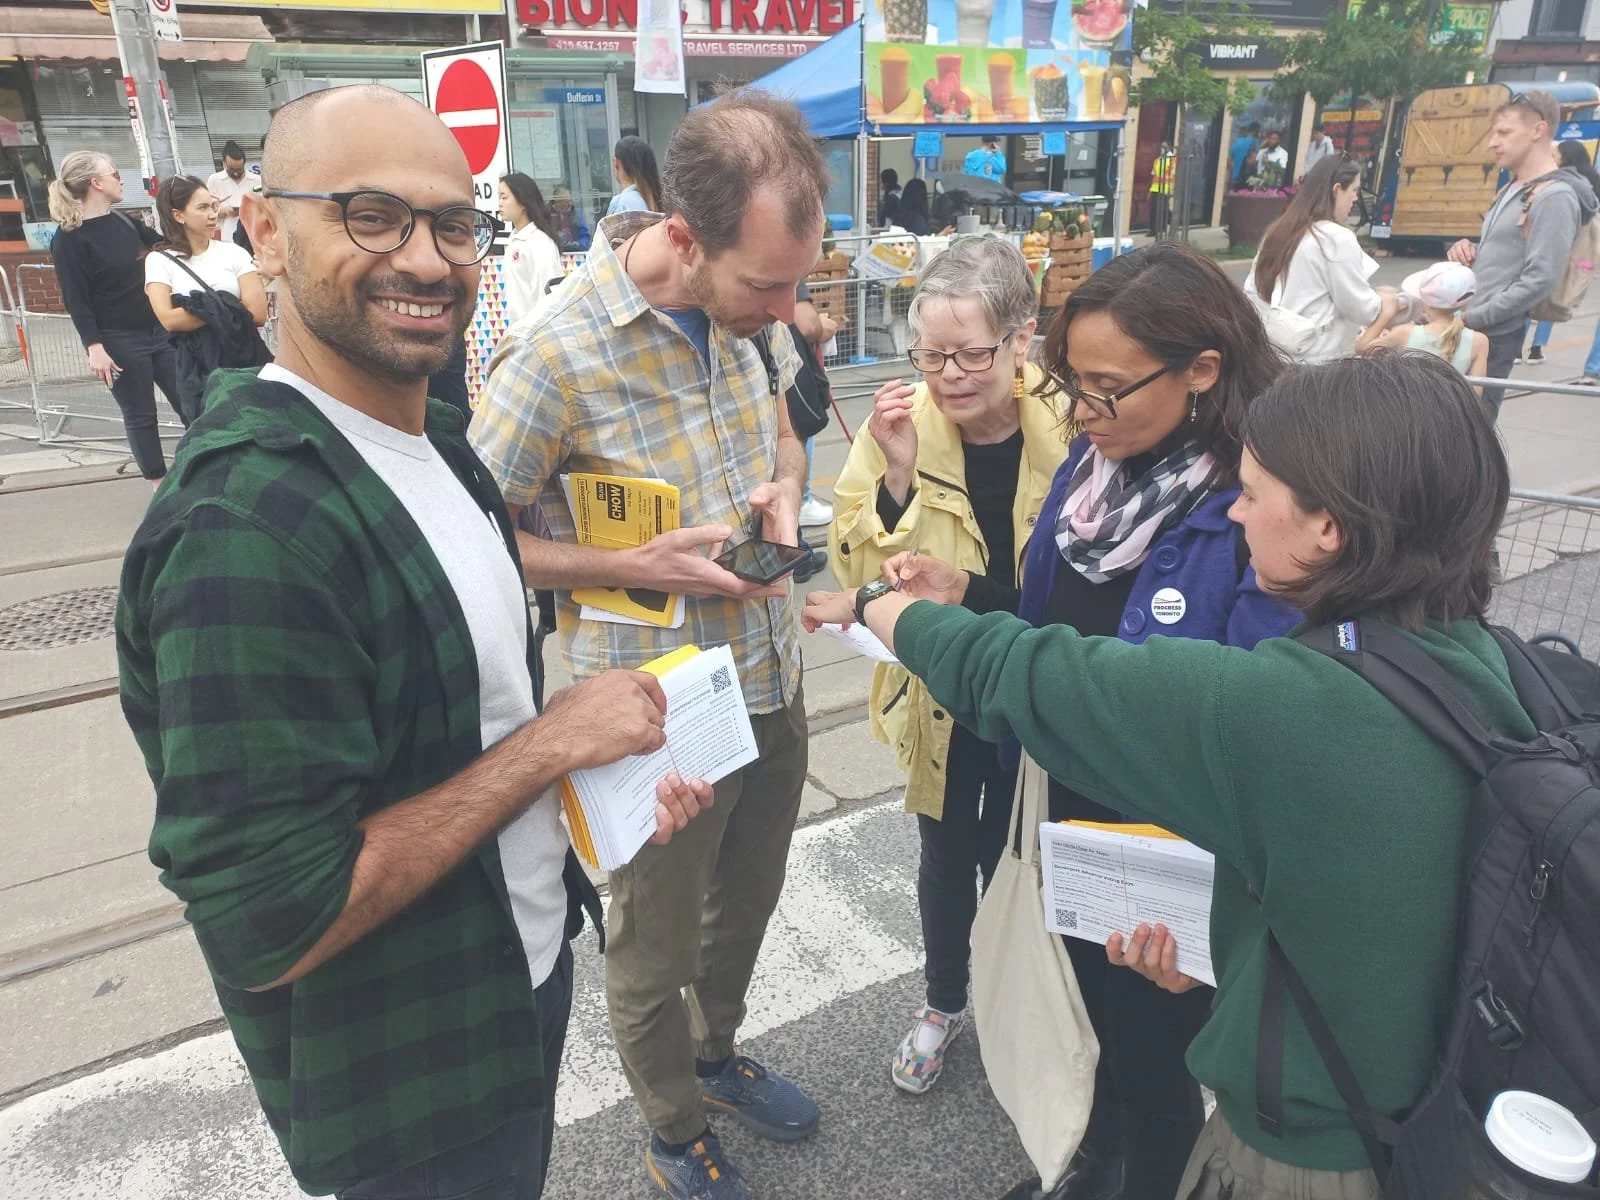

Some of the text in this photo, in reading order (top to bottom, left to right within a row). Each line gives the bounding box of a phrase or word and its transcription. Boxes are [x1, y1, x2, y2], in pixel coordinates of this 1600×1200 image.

[728, 42, 785, 56] SERVICES
[1209, 43, 1259, 59] VIBRANT
[566, 91, 594, 103] Dufferin
[474, 182, 493, 200] AD
[610, 486, 622, 518] CHOW
